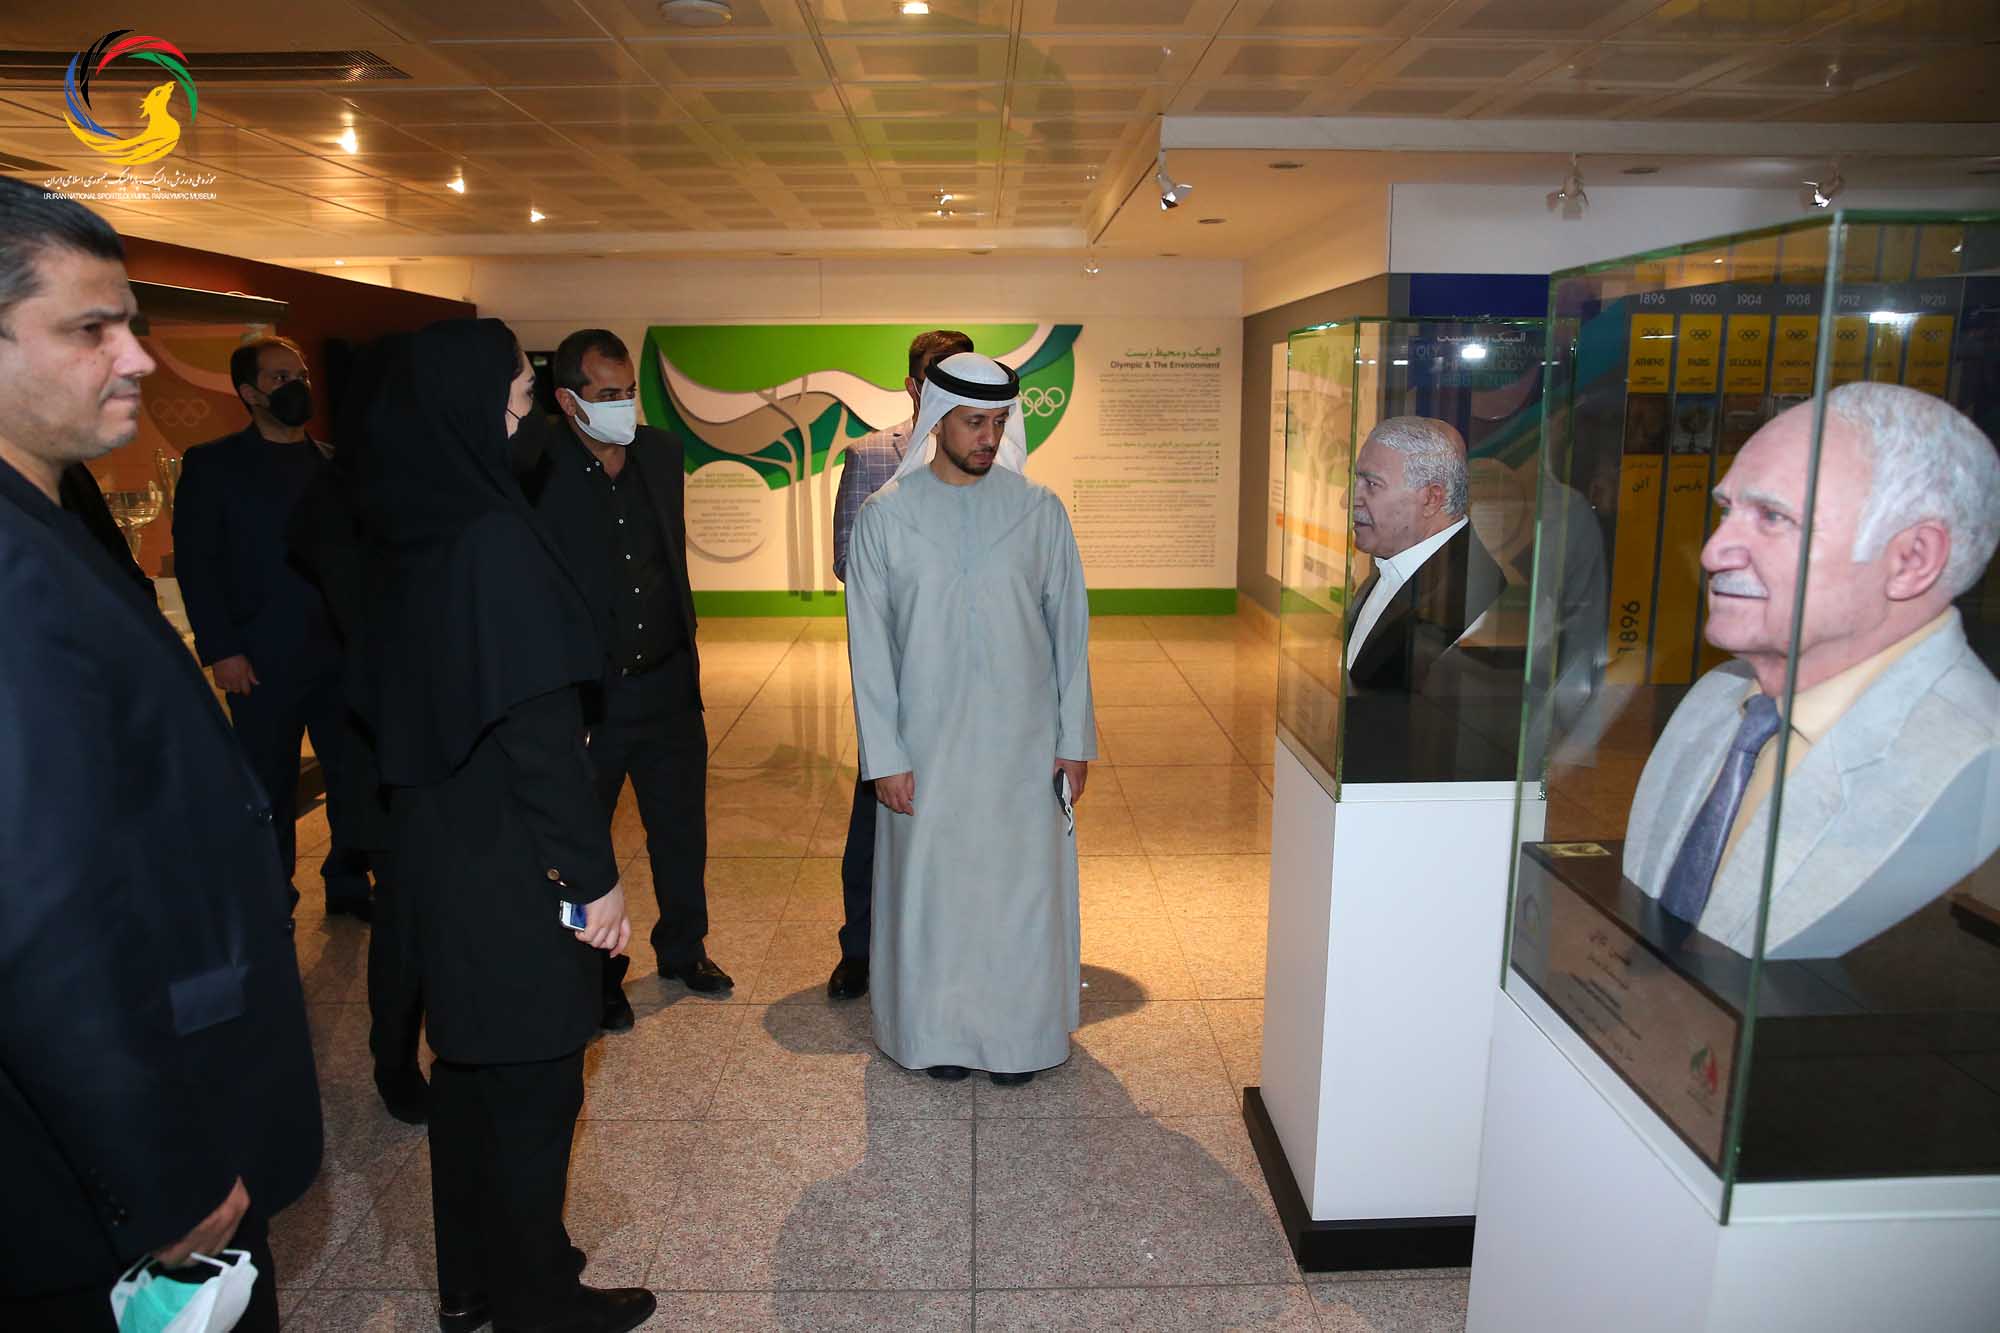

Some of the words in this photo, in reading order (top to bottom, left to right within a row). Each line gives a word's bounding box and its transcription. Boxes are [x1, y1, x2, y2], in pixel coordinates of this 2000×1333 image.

[1639, 291, 1665, 305] 1896
[1688, 293, 1717, 305] 1900
[1736, 293, 1762, 305] 1904
[1784, 293, 1811, 305] 1908
[1110, 360, 1142, 371] Olympic
[1153, 360, 1168, 369] The
[1169, 360, 1220, 369] Environment
[1633, 358, 1665, 367] ATHENS
[1687, 358, 1711, 367] PARIS
[1616, 600, 1640, 654] 1896
